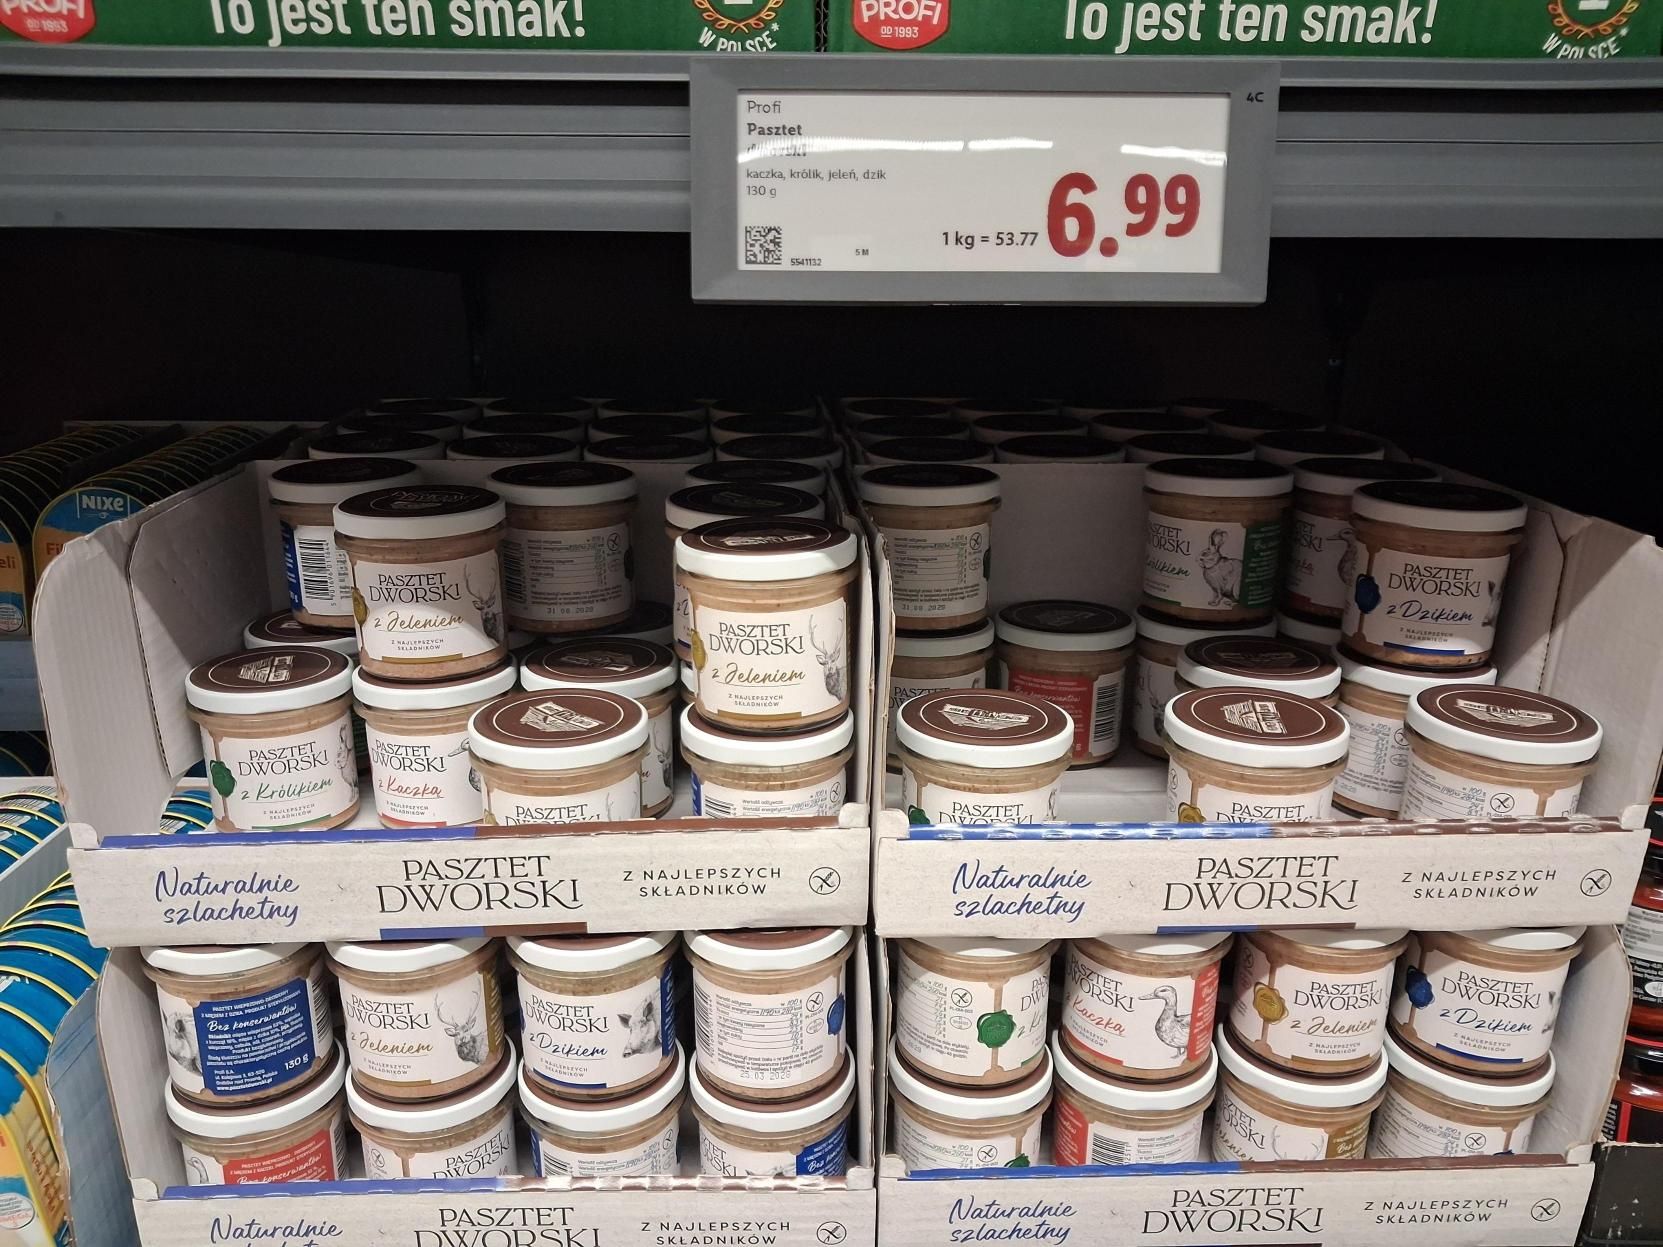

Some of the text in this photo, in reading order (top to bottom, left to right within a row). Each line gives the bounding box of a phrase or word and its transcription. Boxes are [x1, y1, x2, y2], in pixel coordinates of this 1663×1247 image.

[860, 0, 942, 25] PROFI
[267, 0, 351, 47] jest
[361, 0, 436, 36] ten
[449, 0, 586, 38] smak!
[880, 26, 919, 38] OD 1993
[1114, 0, 1205, 54] jest
[1218, 0, 1289, 42] ten
[1300, 0, 1439, 43] smak!
[746, 100, 781, 114] Profi
[1246, 92, 1264, 103] 4C
[746, 123, 802, 136] Pasztet
[746, 169, 886, 181] kaczka, królik, jeleń, dzik
[746, 185, 777, 198] 130 g
[1047, 172, 1201, 258] 6.99
[942, 231, 949, 246] 1
[954, 231, 975, 249] kg
[995, 231, 1038, 246] 53.77
[790, 258, 822, 267] 5541132
[46, 542, 65, 556] Fi
[378, 572, 446, 587] PASZTET
[1403, 563, 1474, 580] PASZTET
[369, 583, 462, 603] DWORSKI
[1388, 573, 1481, 598] DWORSKI
[374, 610, 464, 632] z Jeleniem
[1386, 600, 1473, 622] z Dzikiem
[719, 622, 790, 638] PASZTET
[709, 633, 806, 656] DWORSKI
[712, 662, 806, 684] z Jeleniem
[248, 741, 317, 761] PASZTET
[375, 739, 431, 757] PASZTET
[238, 750, 330, 776] DWORSKI
[371, 752, 447, 772] DWORSKI
[241, 778, 334, 801] z Królikiem
[515, 804, 588, 820] PASZTET
[952, 801, 1024, 818] PASZTET
[1231, 802, 1305, 819] PASZTET
[402, 855, 551, 882] PASZTET
[623, 866, 782, 882] Z NAJLEPSZYCH
[952, 859, 1092, 894] Naturalnie
[1196, 855, 1339, 879] PASZTET
[1401, 869, 1557, 883] Z NAJLEPSZYCH
[155, 866, 299, 902] Naturalnie
[639, 883, 767, 898] SKŁADNIKÓW
[1413, 885, 1539, 899] SKŁADNIKÓW
[375, 879, 584, 914] DWORSKI
[1162, 879, 1359, 911] DWORSKI
[163, 896, 299, 927] szlachetny
[954, 890, 1086, 922] szlachetny
[1310, 980, 1377, 996] PASZTET
[1458, 970, 1534, 993] PASZTET
[1293, 988, 1383, 1011] DWORSKI
[1441, 977, 1541, 1009] DWORSKI
[346, 1000, 432, 1030] DWORSKI
[351, 994, 414, 1015] PASZTET
[532, 994, 594, 1017] PASZTET
[207, 1021, 230, 1032] Bez
[525, 1001, 610, 1033] DWORSKI
[1290, 1016, 1377, 1035] z Jeleniem
[1439, 1007, 1533, 1033] z Dzikiem
[359, 1031, 434, 1055] Jeleniem
[529, 1032, 608, 1057] z Dzikiem
[284, 1058, 301, 1070] 130
[302, 1053, 309, 1063] g
[445, 1130, 503, 1170] PASZTET
[1171, 1187, 1304, 1208] PASZTET
[1364, 1199, 1509, 1211] Z NAJLEPSZYCH
[438, 1207, 575, 1227] PASZTET
[949, 1195, 1078, 1224] Naturalnie
[1375, 1213, 1493, 1224] SKŁADNIKÓW
[210, 1214, 344, 1243] Naturalnie
[641, 1221, 791, 1232] Z NAJLEPSZYCH
[1141, 1207, 1325, 1234] DWORSKI
[414, 1228, 603, 1247] DWORSKI
[656, 1234, 777, 1246] SKŁADNIKÓW
[950, 1220, 1072, 1246] szlachetny
